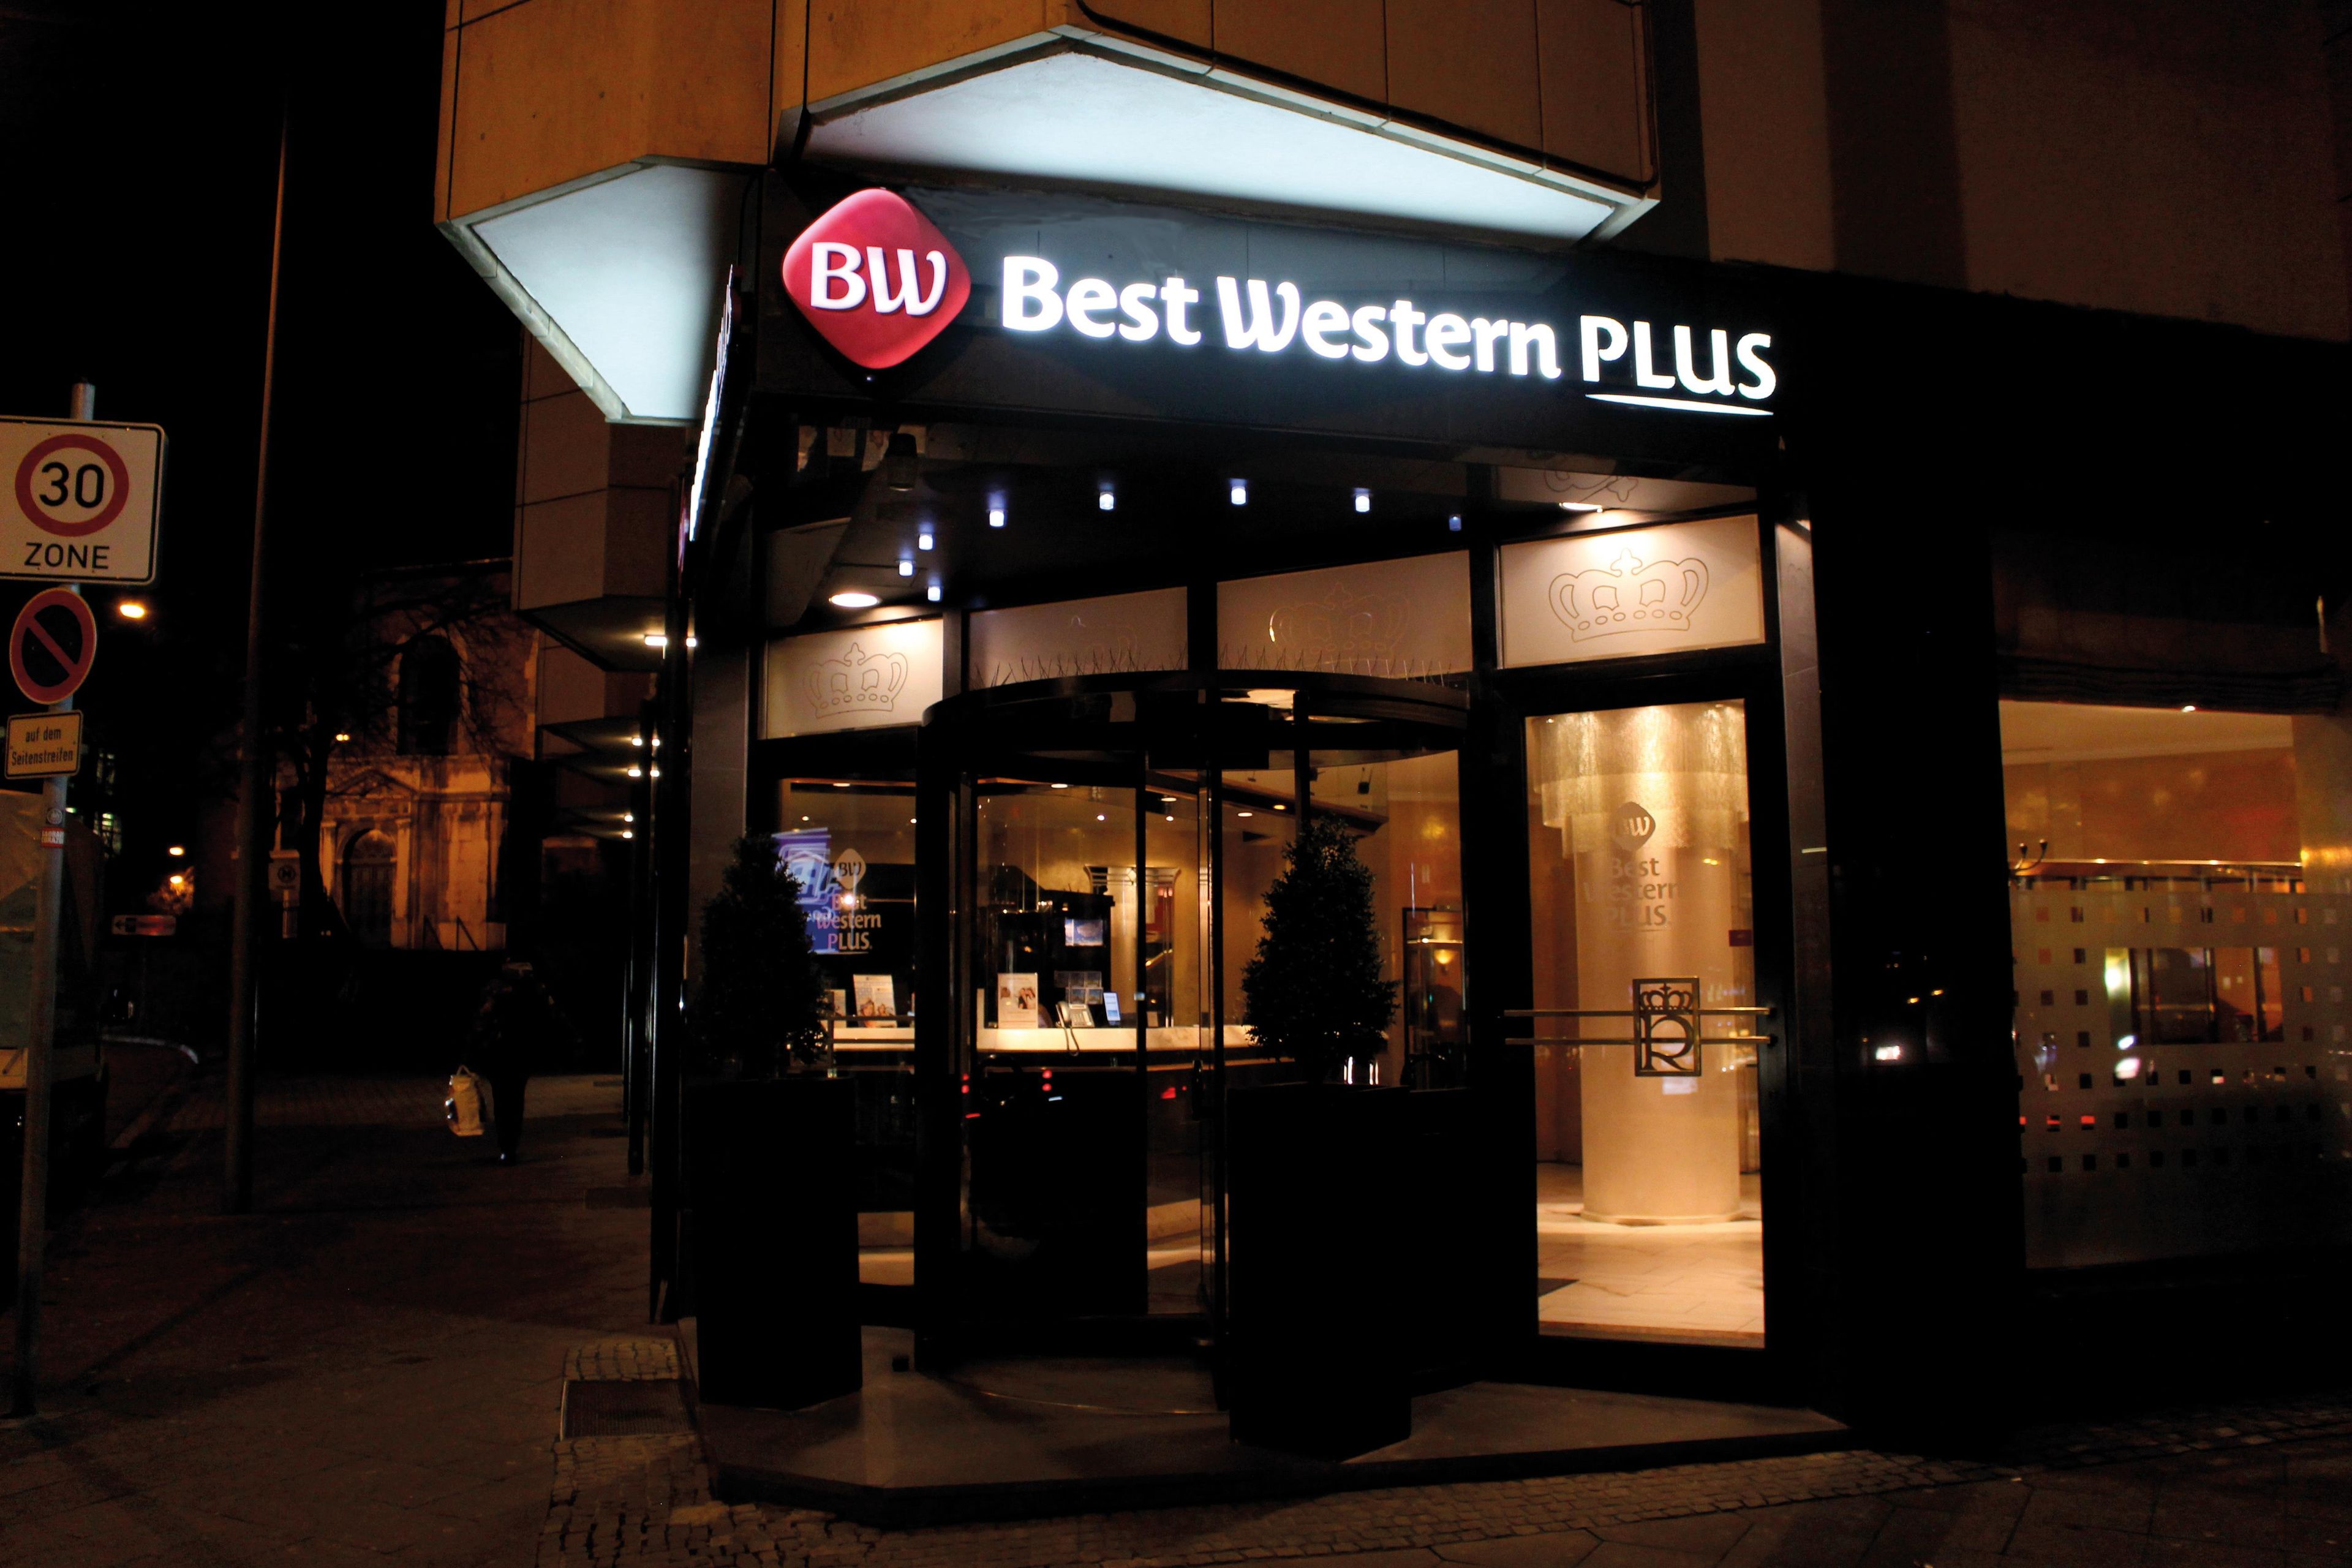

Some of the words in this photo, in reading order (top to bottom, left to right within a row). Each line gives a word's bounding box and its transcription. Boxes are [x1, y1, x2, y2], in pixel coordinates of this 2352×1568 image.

[810, 242, 948, 316] BW
[1002, 255, 1202, 346] Best
[1216, 276, 1562, 379] Western
[1580, 315, 1777, 400] PLUS
[39, 462, 105, 508] 30
[24, 542, 110, 570] ZONE
[25, 726, 39, 742] auf
[43, 726, 61, 741] dem
[12, 747, 73, 766] Seitenstreifen
[839, 862, 861, 876] BW
[832, 893, 867, 911] Bt
[1583, 881, 1679, 903] estern
[816, 911, 881, 929] Western
